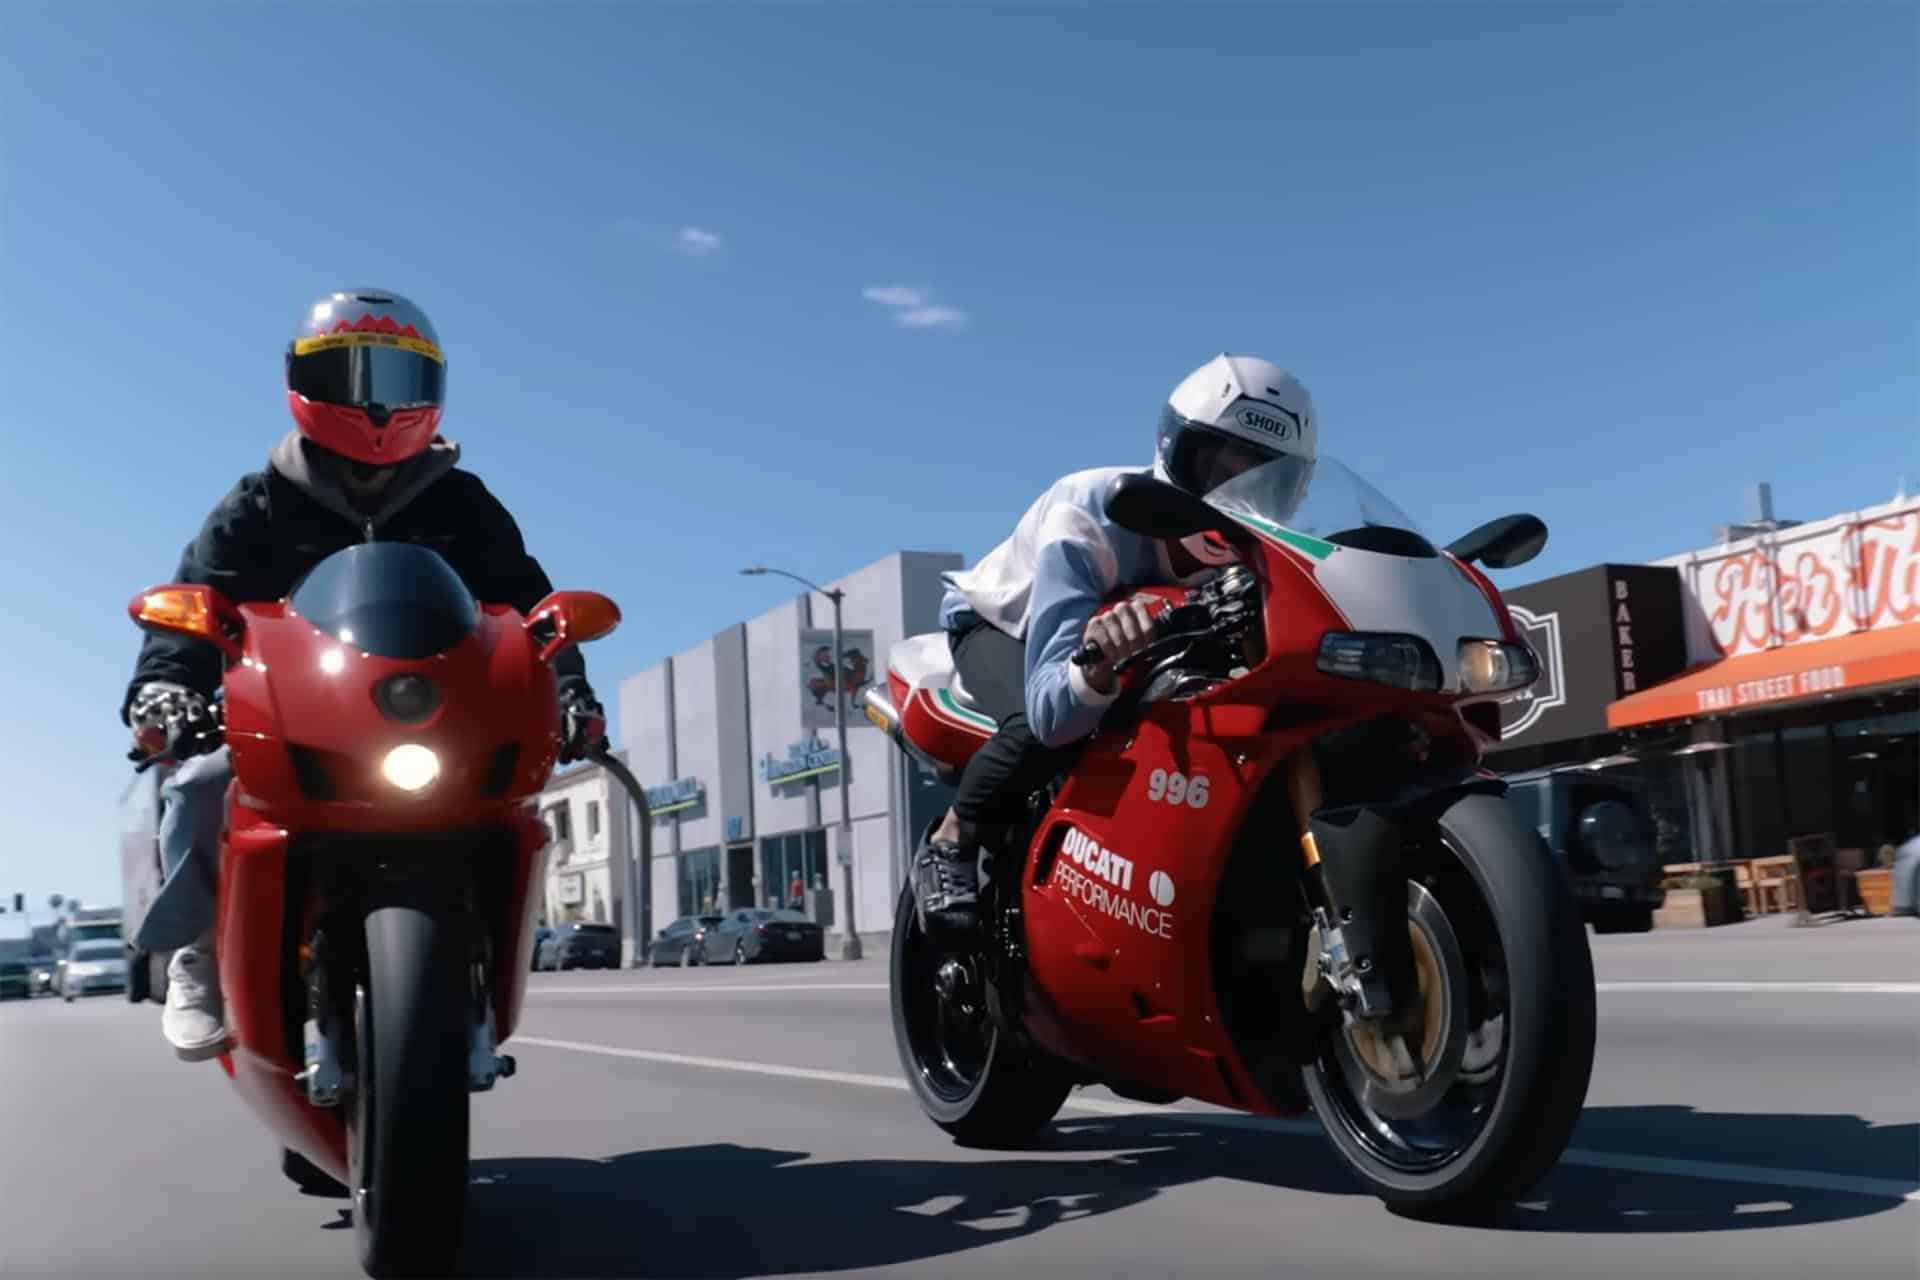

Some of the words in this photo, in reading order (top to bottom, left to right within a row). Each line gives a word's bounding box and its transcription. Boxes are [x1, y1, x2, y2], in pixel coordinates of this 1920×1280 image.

[1244, 412, 1287, 437] SHOEI
[1696, 687, 1732, 711] THAI
[1737, 675, 1795, 704] STREET
[1800, 666, 1845, 693] FOOD
[1148, 768, 1210, 809] 996
[1062, 827, 1134, 891] DUCATI
[1054, 860, 1174, 939] PERFORMANCE
